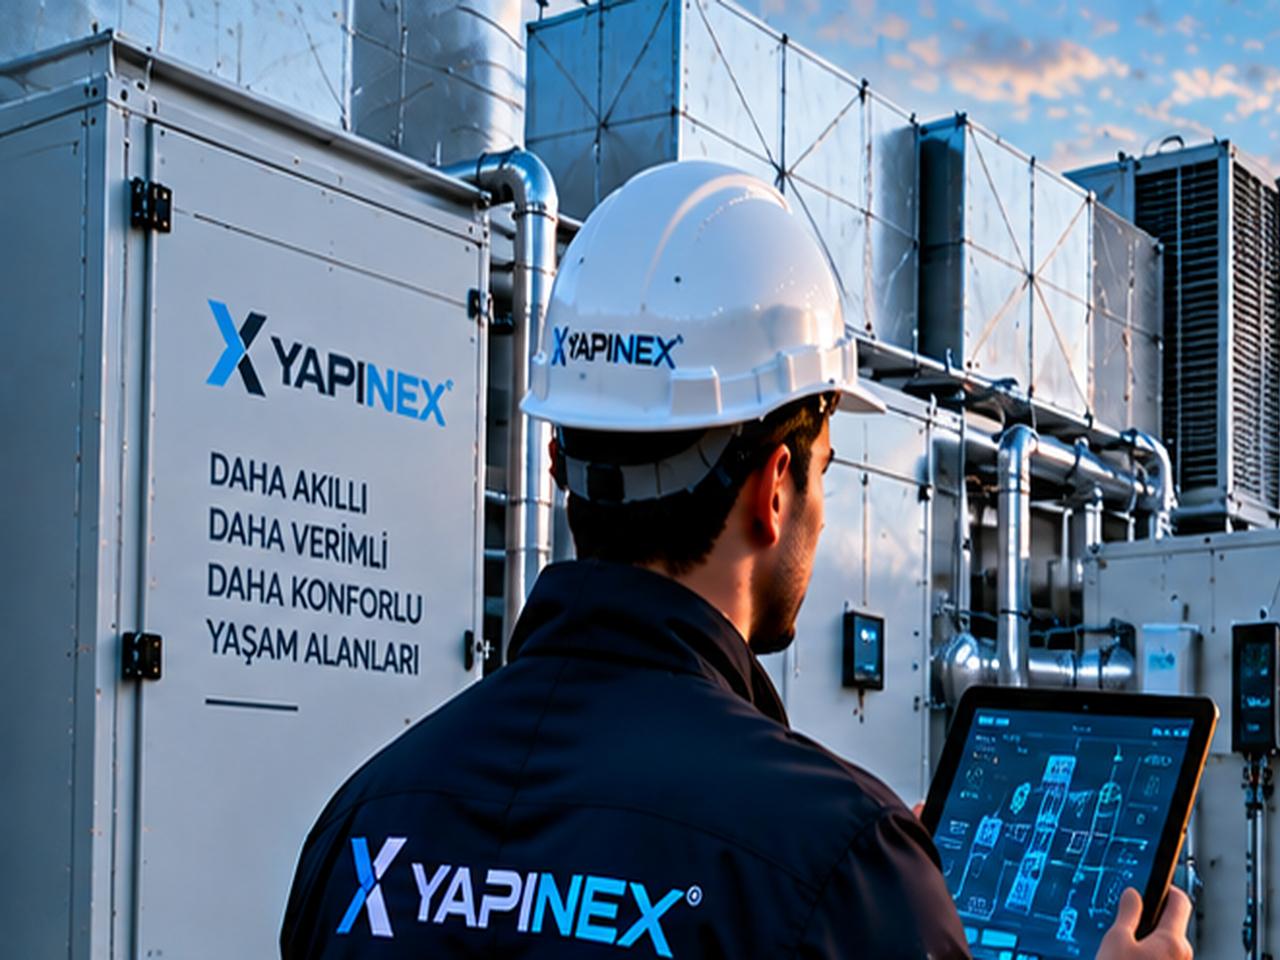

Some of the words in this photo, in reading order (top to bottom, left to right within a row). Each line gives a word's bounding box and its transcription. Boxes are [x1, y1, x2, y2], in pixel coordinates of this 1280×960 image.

[271, 335, 447, 427] YAPINEX
[568, 332, 678, 370] YAPINEX
[210, 451, 287, 500] DAHA
[292, 469, 367, 515] AKILLI
[209, 506, 286, 553] DAHA
[291, 521, 388, 571] VERİMLİ
[207, 562, 285, 607] DAHA
[291, 575, 423, 625] KONFORLU
[205, 618, 299, 666] YAŞAM
[303, 631, 419, 676] ALANLARI
[411, 862, 685, 958] YAPINEX
